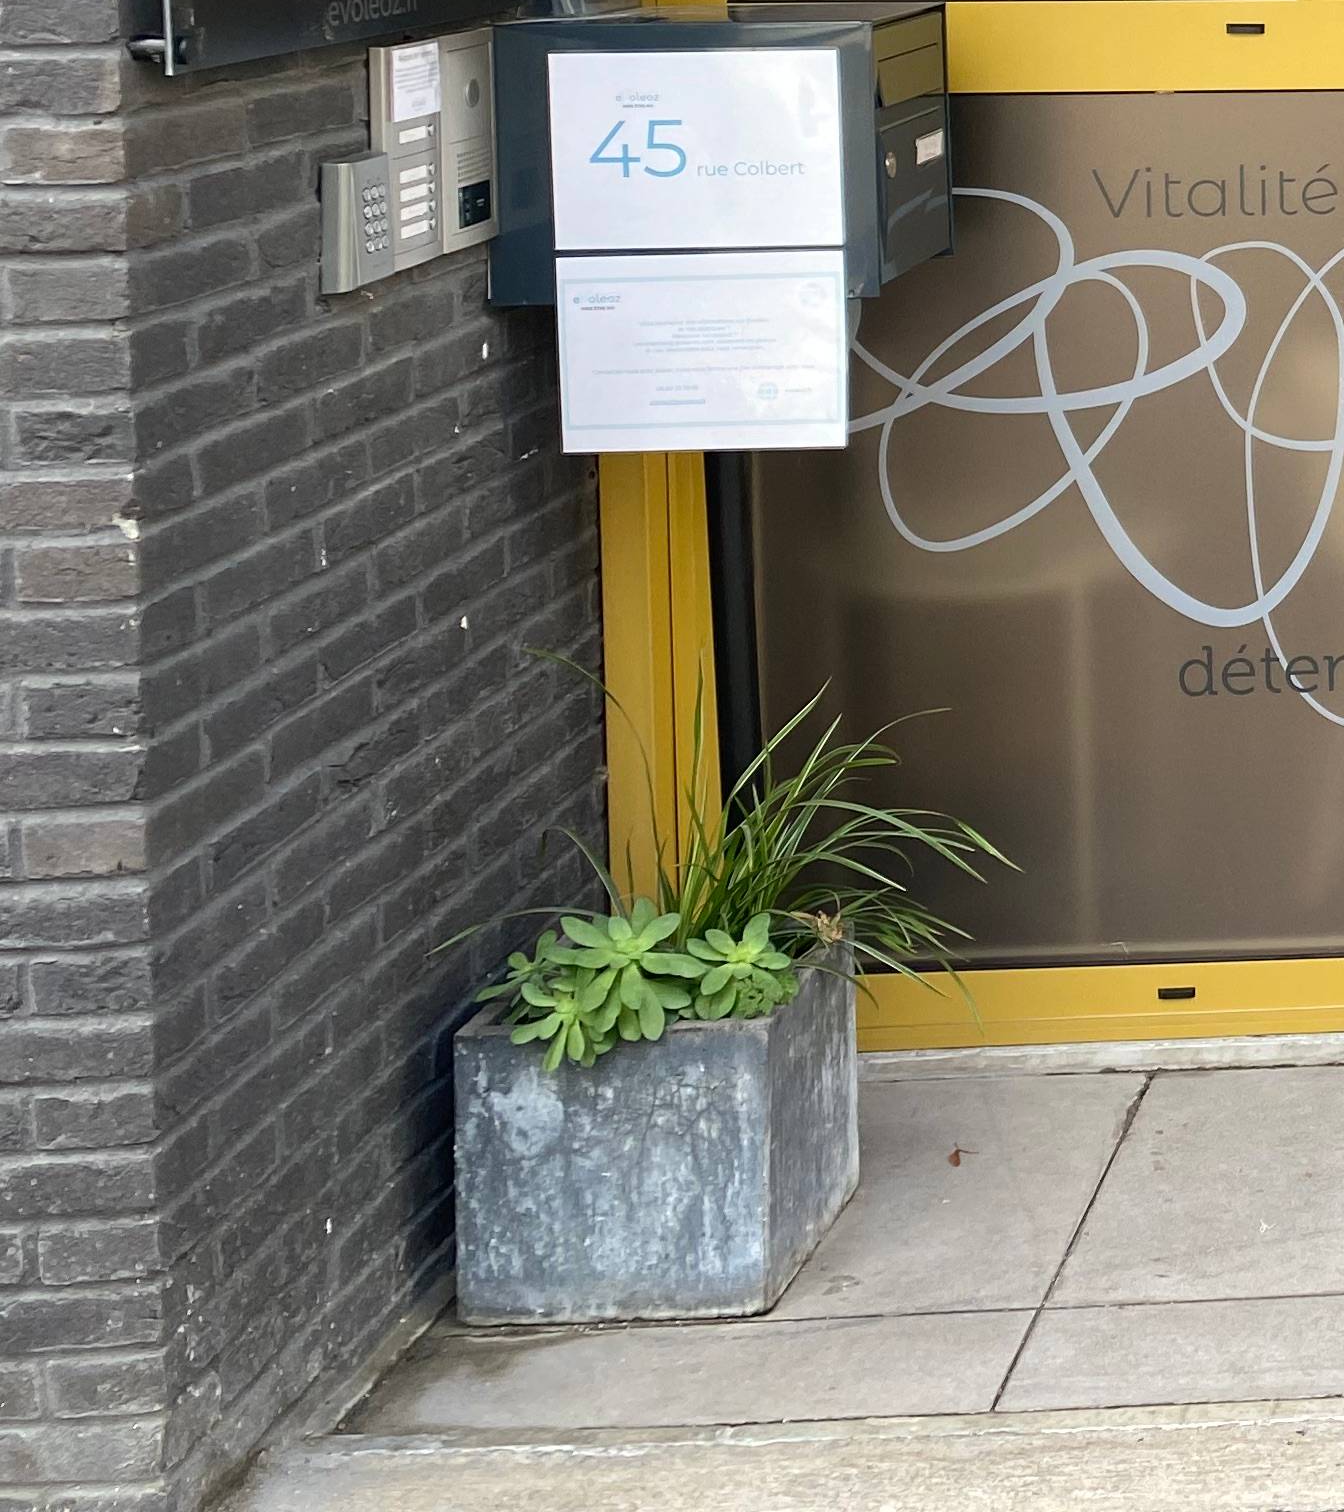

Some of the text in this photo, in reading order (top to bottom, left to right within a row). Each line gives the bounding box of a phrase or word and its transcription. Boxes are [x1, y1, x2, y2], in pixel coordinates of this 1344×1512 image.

[590, 120, 805, 178] 45 rue Colbert
[1093, 163, 1340, 219] Vitalité
